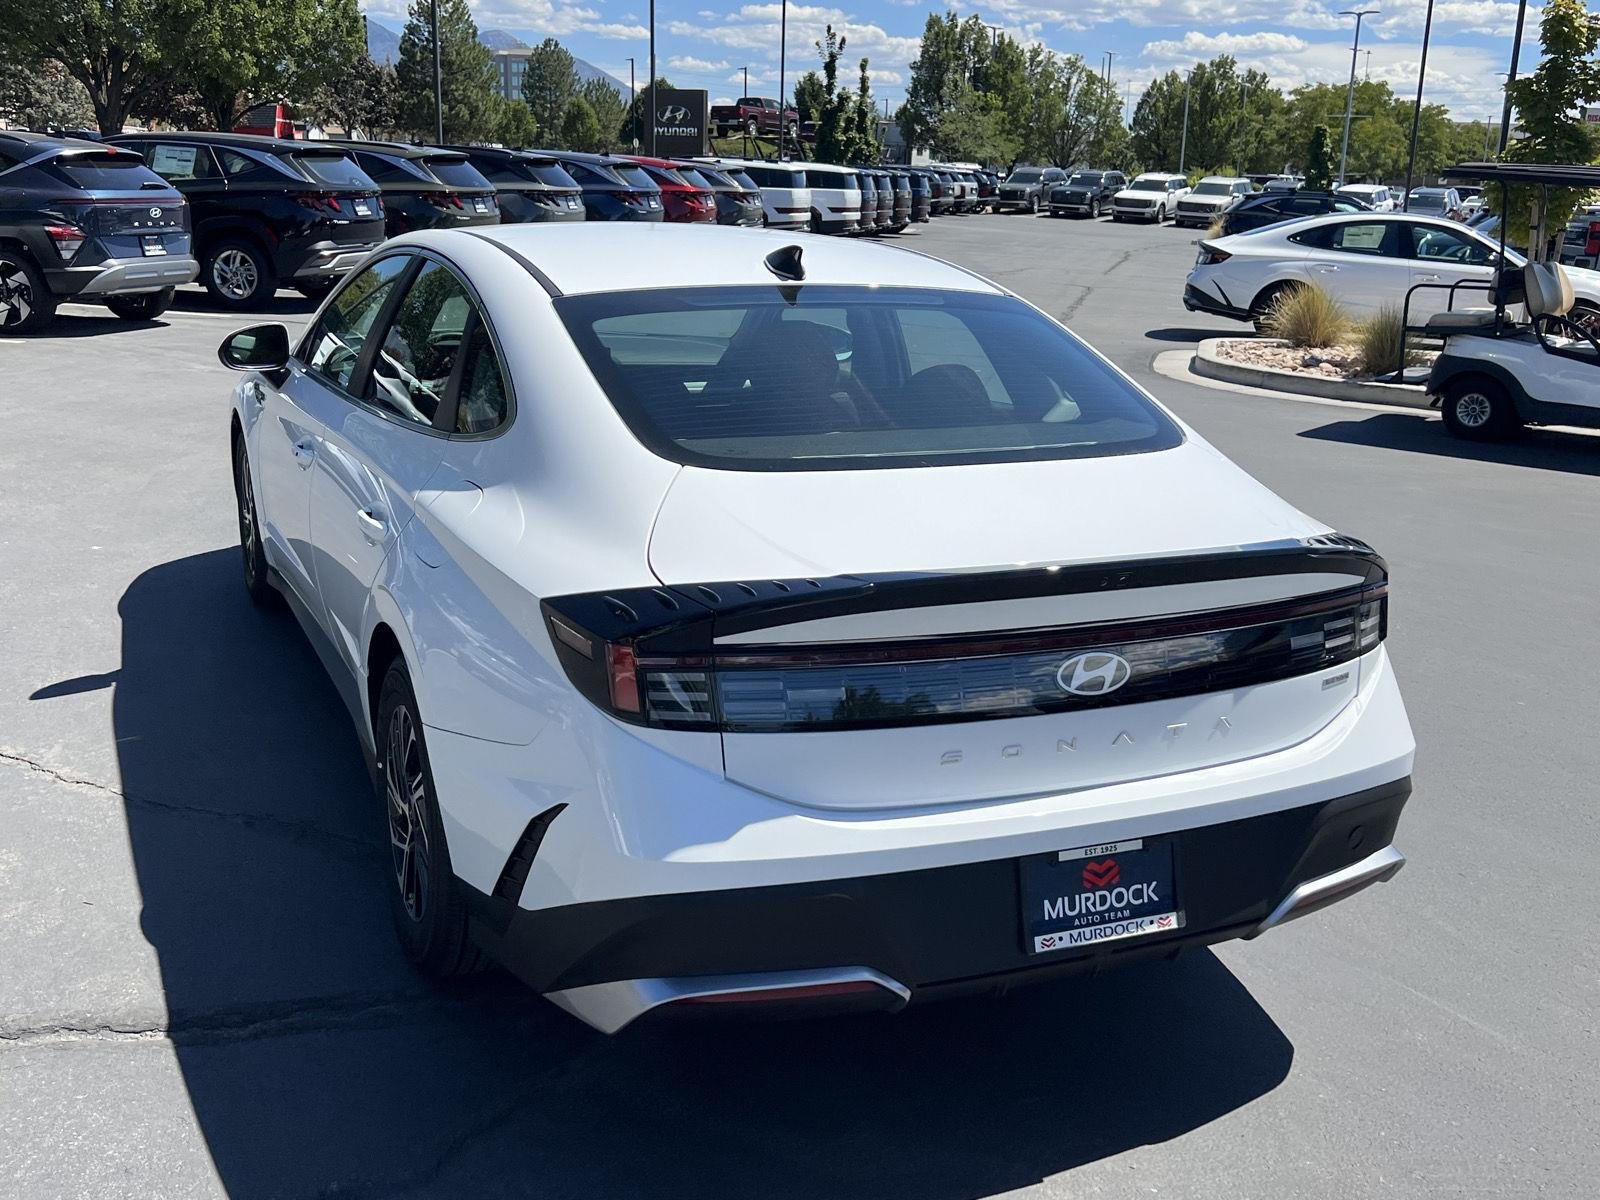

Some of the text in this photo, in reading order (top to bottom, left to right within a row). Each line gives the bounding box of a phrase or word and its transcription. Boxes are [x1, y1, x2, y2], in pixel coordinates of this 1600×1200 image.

[940, 716, 1232, 766] SONATA
[1084, 844, 1118, 856] EST. 1925
[1043, 880, 1159, 921] MURDOCK
[1073, 909, 1131, 926] AUTO TEAM
[1069, 919, 1146, 945] MURDOCK
